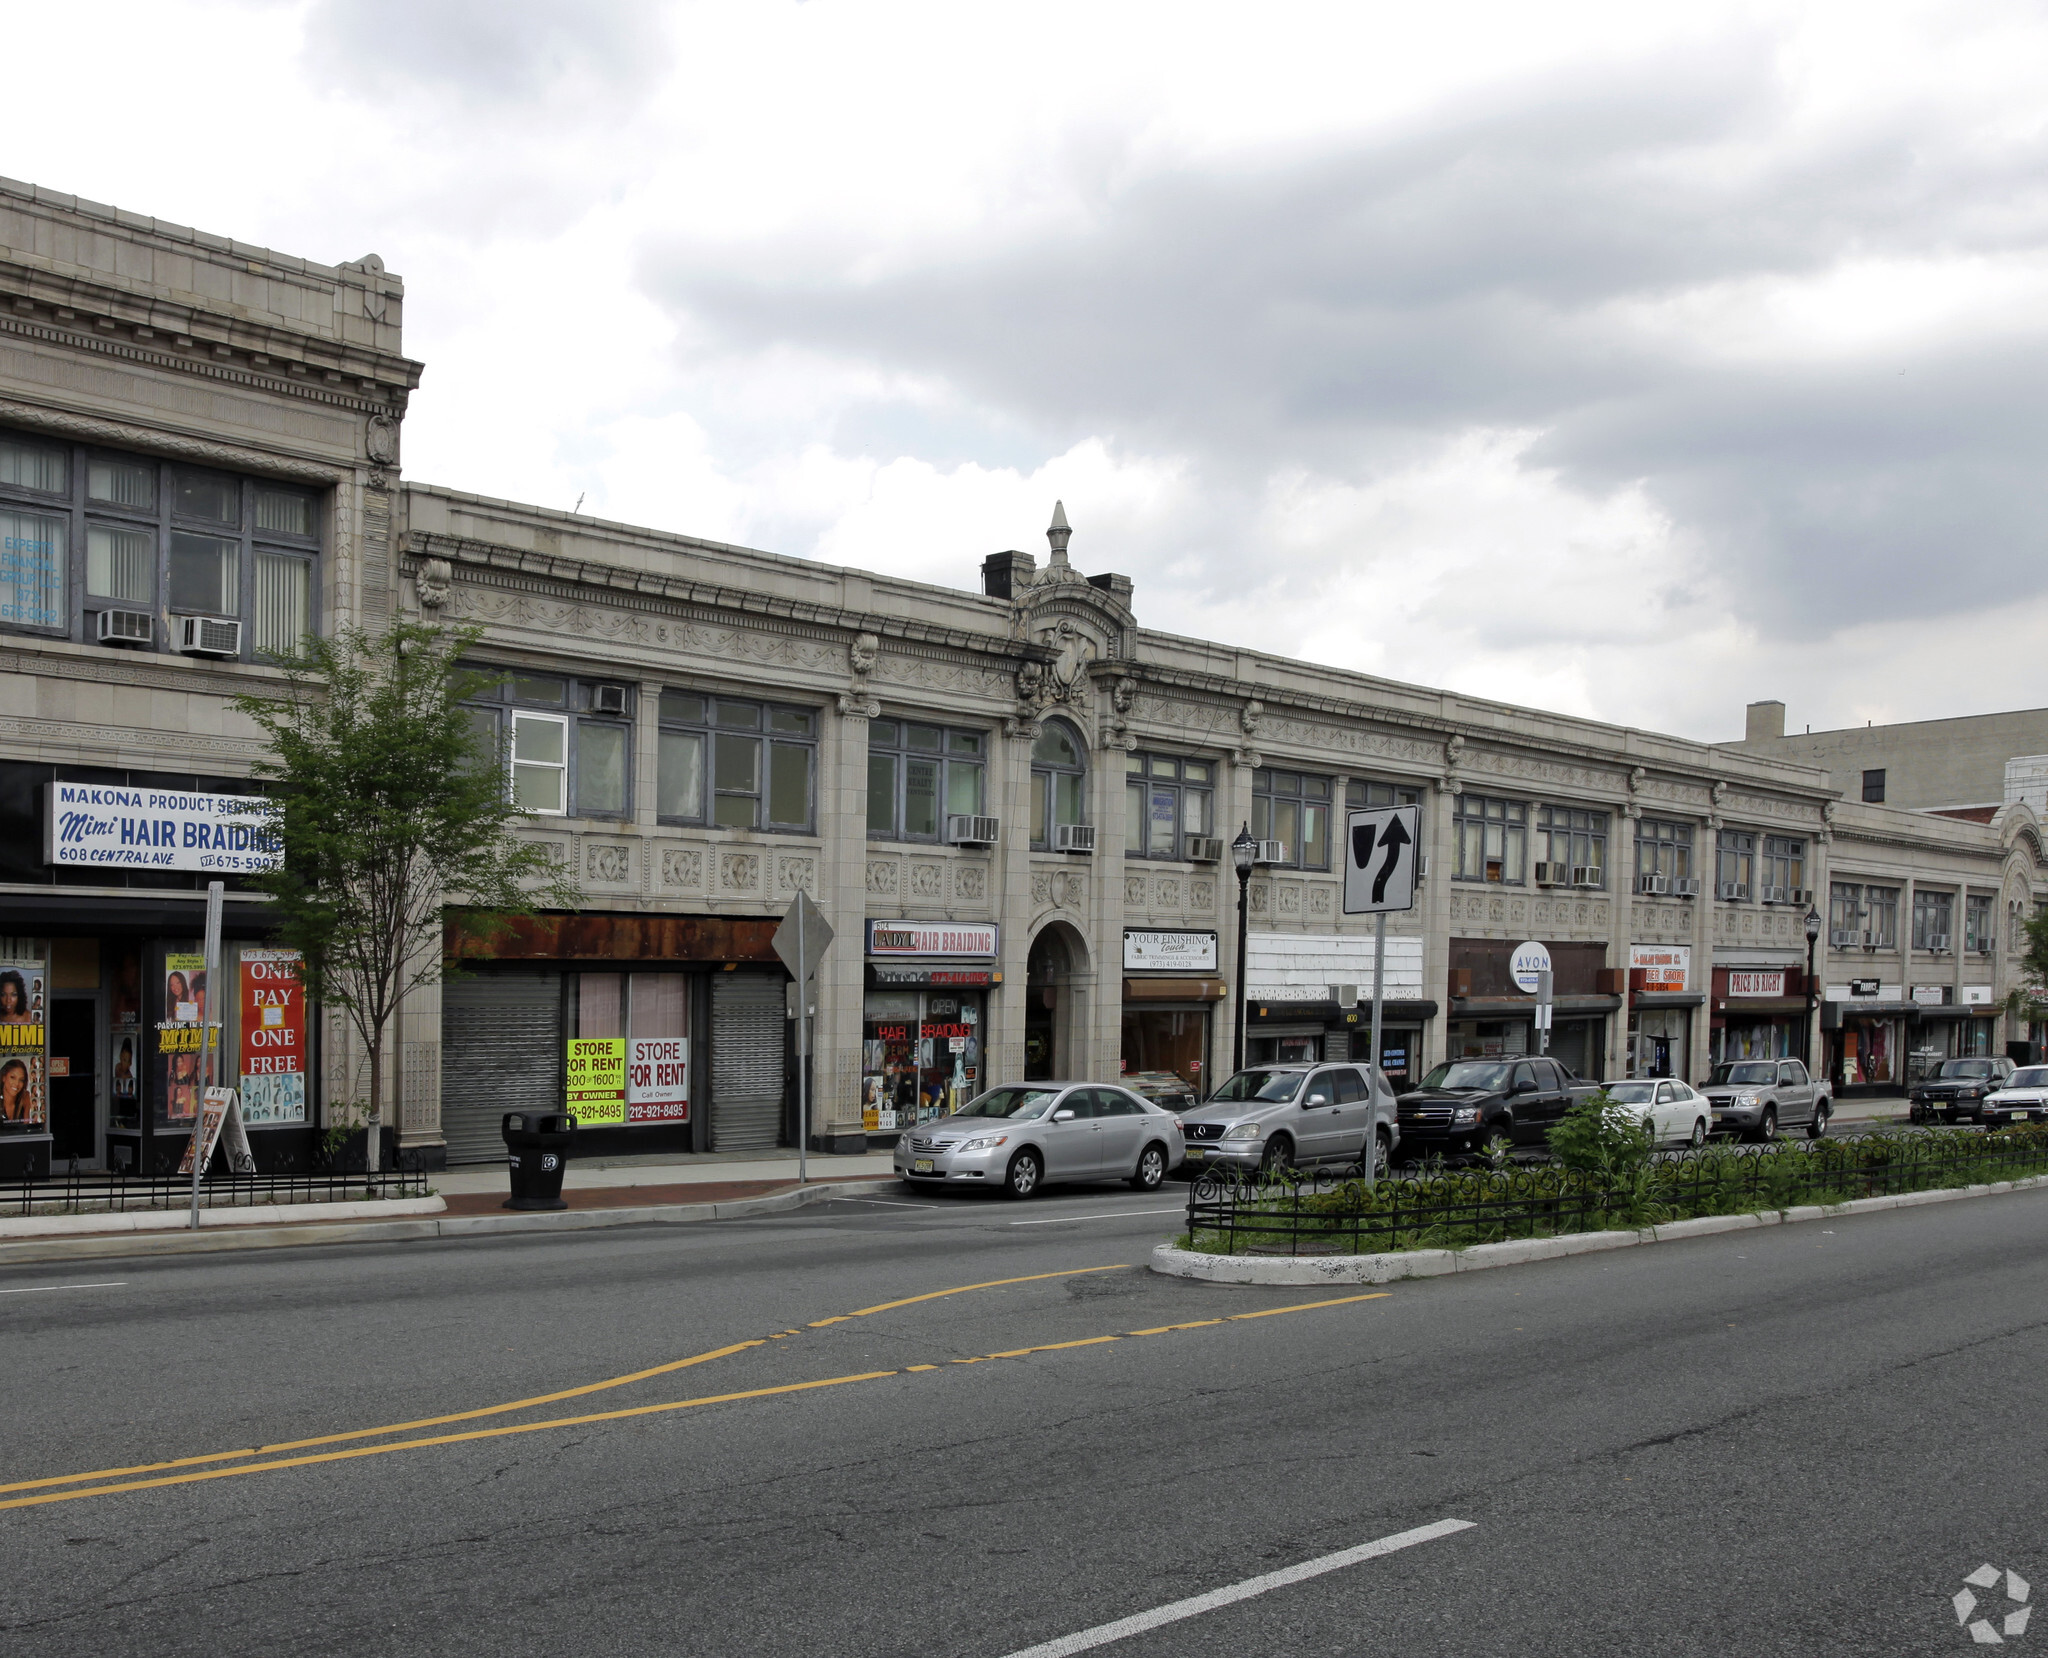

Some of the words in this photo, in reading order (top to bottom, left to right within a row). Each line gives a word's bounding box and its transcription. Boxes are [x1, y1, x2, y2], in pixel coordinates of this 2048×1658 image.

[5, 537, 54, 554] EXPERTS
[1, 553, 57, 572] FINANCIAL
[0, 570, 36, 585] GROUP
[40, 575, 61, 589] LLC
[61, 787, 143, 808] MAKONA
[149, 794, 214, 812] PRODUCT
[59, 811, 118, 843] Mimi
[121, 817, 176, 847] HAIR
[183, 822, 282, 852] BRAIDING
[60, 847, 87, 861] 608
[90, 848, 149, 864] CENTRAL
[151, 852, 175, 865] AVE.
[874, 931, 907, 947] LADY
[915, 932, 939, 951] HAIR
[942, 932, 991, 952] BRAIDING
[1133, 934, 1159, 943] YOUR
[1161, 934, 1209, 945] FINISHING
[251, 962, 295, 979] ONE
[1517, 957, 1549, 968] AVON
[1663, 969, 1686, 981] STORE
[1732, 974, 1751, 992] PRICE
[1753, 974, 1760, 992] IS
[1762, 974, 1781, 992] RIGHT
[253, 989, 292, 1007] PAY
[931, 999, 957, 1014] OPEN
[251, 1029, 295, 1046] ONE
[878, 1026, 906, 1040] HAIR
[921, 1023, 971, 1038] BRAIDING
[11, 1046, 44, 1054] Braiding
[574, 1043, 613, 1055] STORE
[636, 1042, 680, 1061] STORE
[249, 1056, 297, 1074] FREE
[592, 1058, 623, 1071] RENT
[593, 1074, 615, 1085] 1600
[630, 1064, 651, 1087] FOR
[657, 1063, 685, 1086] RENT
[567, 1092, 579, 1100] BY
[582, 1091, 617, 1100] OWNER
[642, 1091, 653, 1099] Call
[630, 1104, 683, 1119] 212-921-8495
